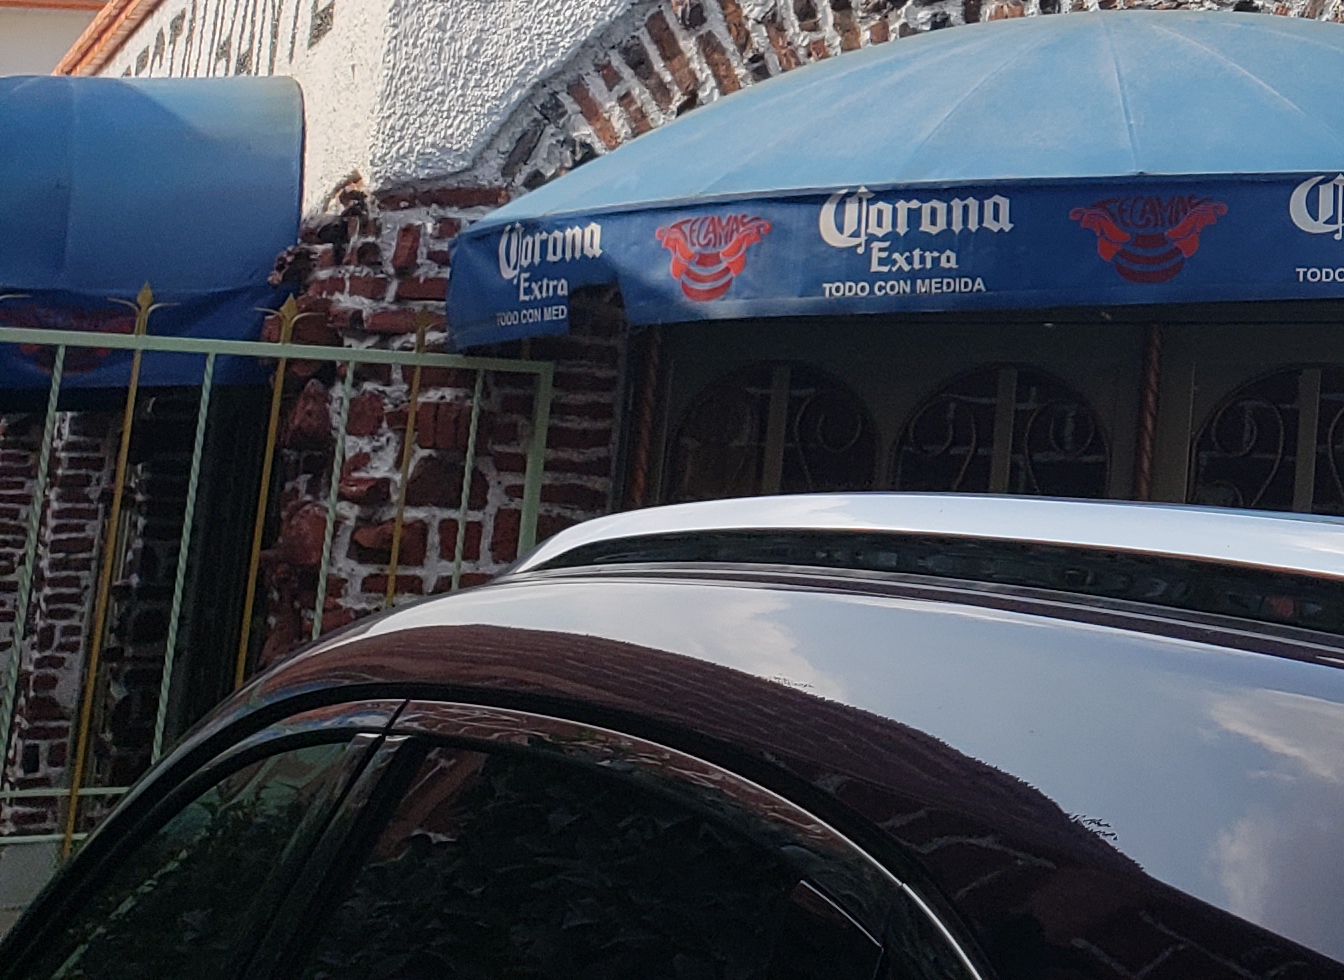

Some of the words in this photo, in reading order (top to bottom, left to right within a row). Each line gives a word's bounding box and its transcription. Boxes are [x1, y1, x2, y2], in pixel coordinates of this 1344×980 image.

[819, 185, 1015, 254] Corona
[498, 221, 603, 285] Corona
[869, 241, 959, 273] Extra
[519, 272, 568, 302] Extra
[822, 282, 870, 298] TODO
[874, 280, 911, 295] CON
[916, 277, 986, 294] MEDIDA
[520, 308, 541, 324] CON
[543, 305, 568, 321] MED
